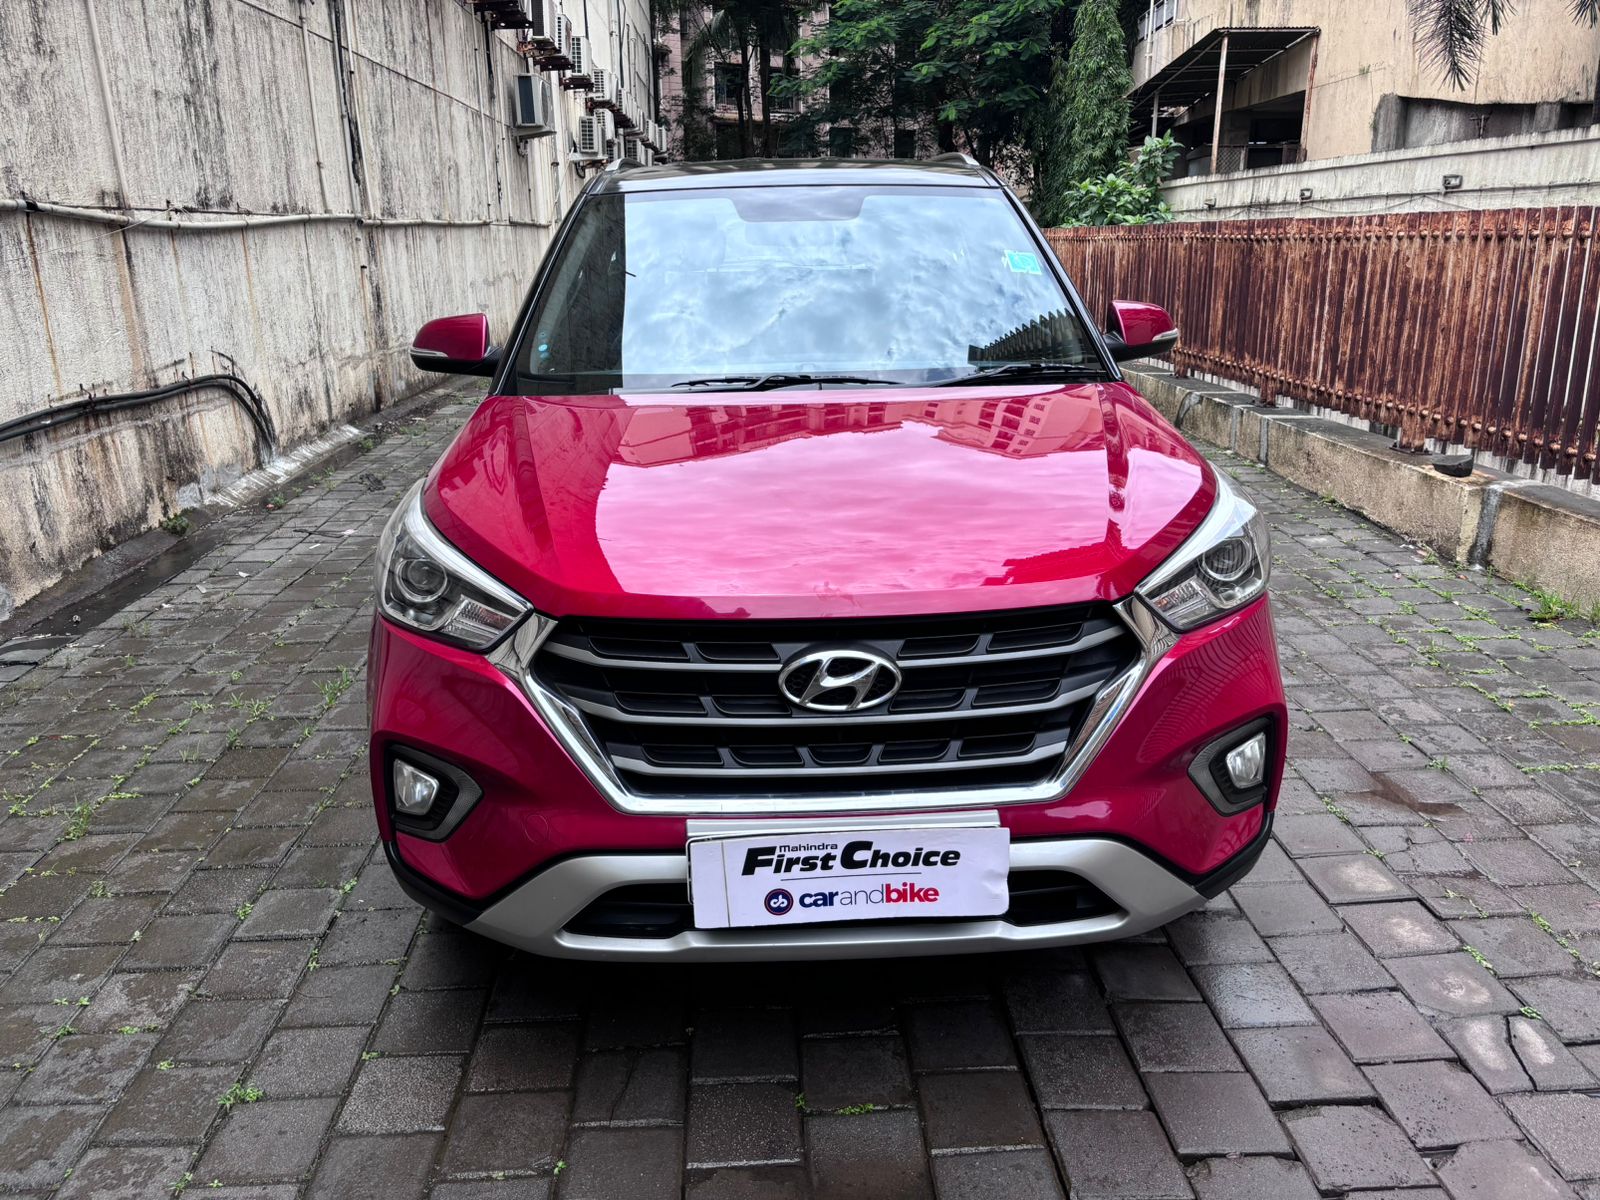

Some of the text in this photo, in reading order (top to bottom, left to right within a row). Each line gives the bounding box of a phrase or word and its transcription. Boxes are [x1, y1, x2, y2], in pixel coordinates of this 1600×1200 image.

[741, 840, 960, 876] First Choice
[778, 842, 838, 853] Mahindra
[799, 882, 940, 908] carandbike
